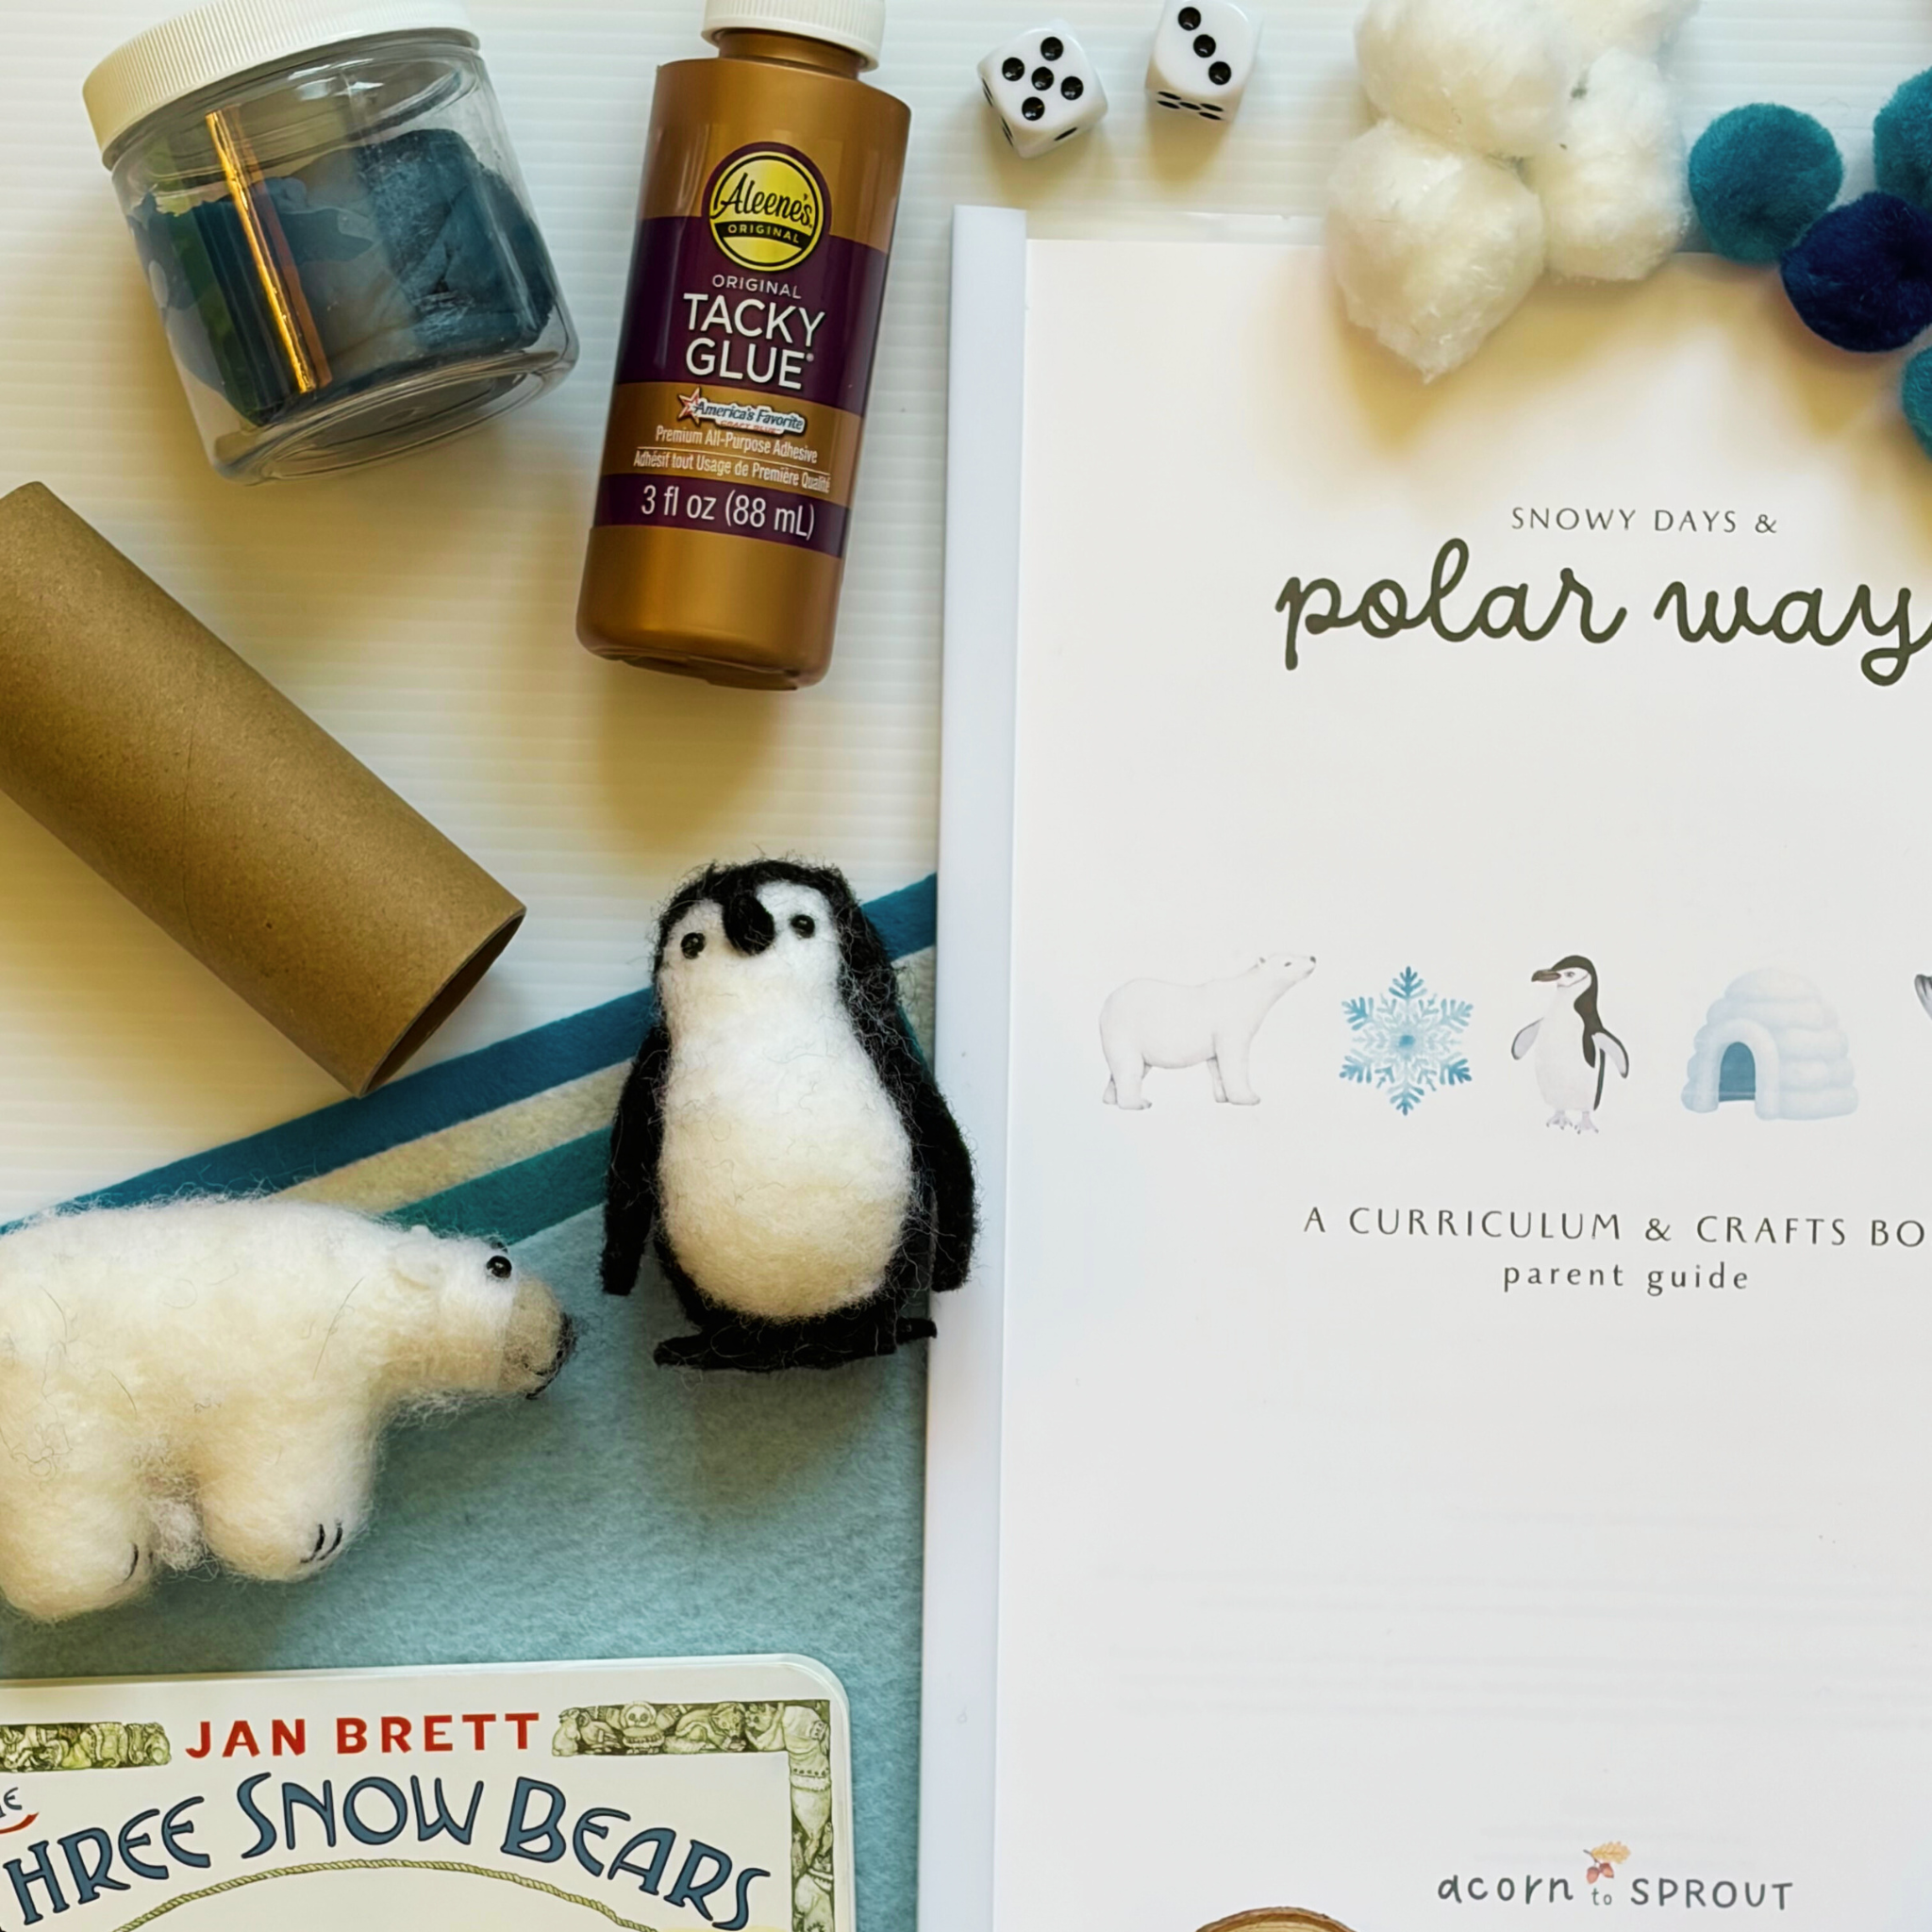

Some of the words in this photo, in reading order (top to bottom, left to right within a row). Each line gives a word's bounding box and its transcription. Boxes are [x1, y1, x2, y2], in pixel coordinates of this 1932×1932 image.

[709, 173, 813, 229] Aleene's
[727, 224, 800, 243] ORIGINAL
[712, 274, 803, 300] ORIGINAL
[683, 292, 826, 347] TACKY
[692, 401, 756, 422] America's
[756, 408, 804, 431] Favorite
[655, 425, 703, 444] Premium
[704, 429, 771, 454] All-Purpose
[773, 441, 819, 464] Adhesive
[633, 449, 670, 468] Adhésif
[670, 451, 694, 469] tout
[695, 452, 732, 477] Usage
[734, 459, 749, 477] de
[751, 461, 801, 487] Première
[801, 471, 831, 494] Qualité
[641, 485, 656, 515] 3
[663, 486, 679, 517] fl
[686, 494, 716, 521] oz
[724, 489, 767, 527] (88
[774, 504, 816, 541] mL)
[1510, 506, 1637, 532] SNOWY
[1653, 508, 1738, 535] DAYS
[1754, 512, 1778, 535] &
[1274, 537, 1628, 672] polar
[1303, 1206, 1327, 1234] A
[1348, 1207, 1621, 1241] CURRICULUM
[1643, 1217, 1673, 1243] &
[1695, 1215, 1847, 1247] CRAFTS
[1503, 1263, 1624, 1293] parent
[1645, 1259, 1749, 1297] guide
[185, 1718, 308, 1759] JAN
[335, 1712, 541, 1756] BRETT
[0, 1796, 211, 1927] HREE
[237, 1772, 484, 1858] SNOW
[500, 1776, 771, 1931] BEARS
[1436, 1873, 1574, 1906] acorn
[1591, 1887, 1613, 1907] to
[1629, 1876, 1794, 1912] SPROUT
